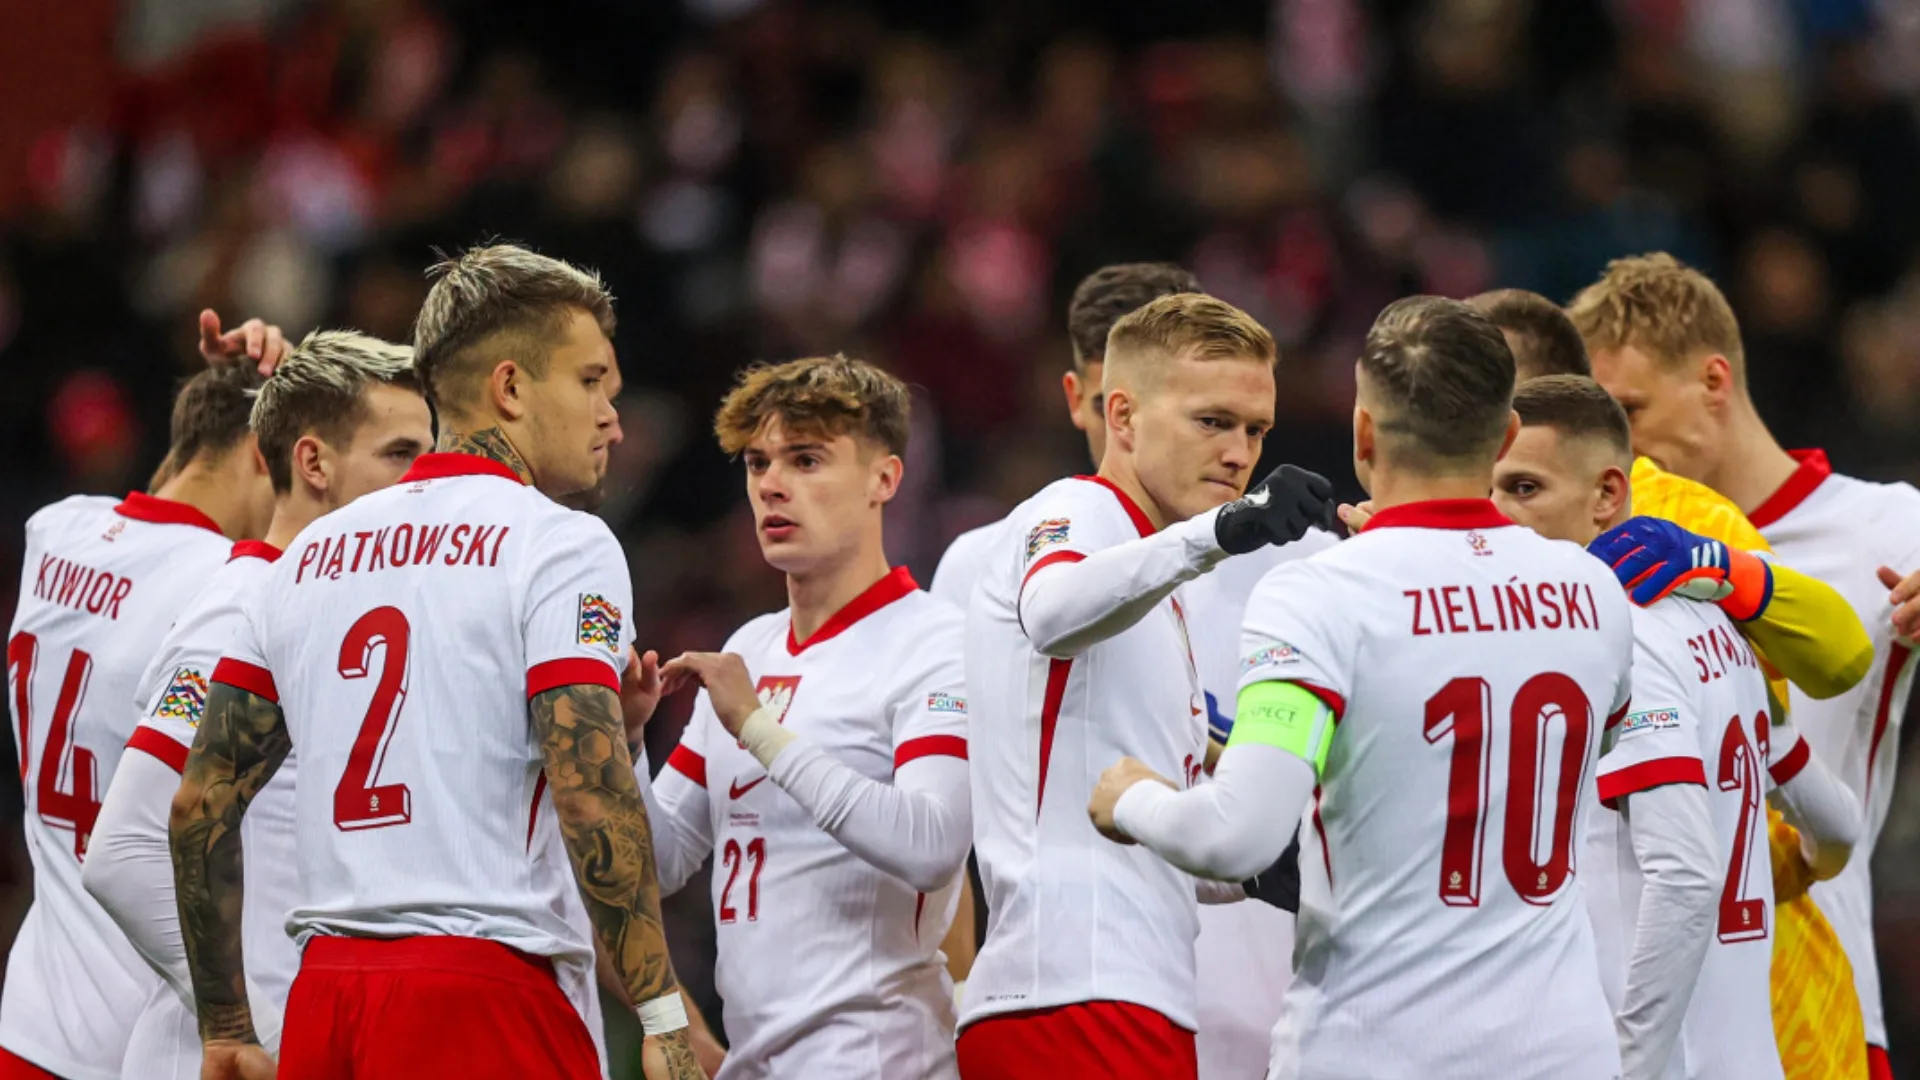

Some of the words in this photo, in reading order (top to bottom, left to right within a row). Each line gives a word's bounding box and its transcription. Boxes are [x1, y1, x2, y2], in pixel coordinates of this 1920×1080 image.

[33, 551, 133, 621] KIWIOR
[295, 522, 510, 585] PIĄTKOWSKI
[1402, 574, 1600, 636] ZIELIŃSKI
[7, 629, 103, 864] 14
[333, 605, 411, 832] 2
[1423, 671, 1595, 907] 10
[720, 837, 766, 925] 21
